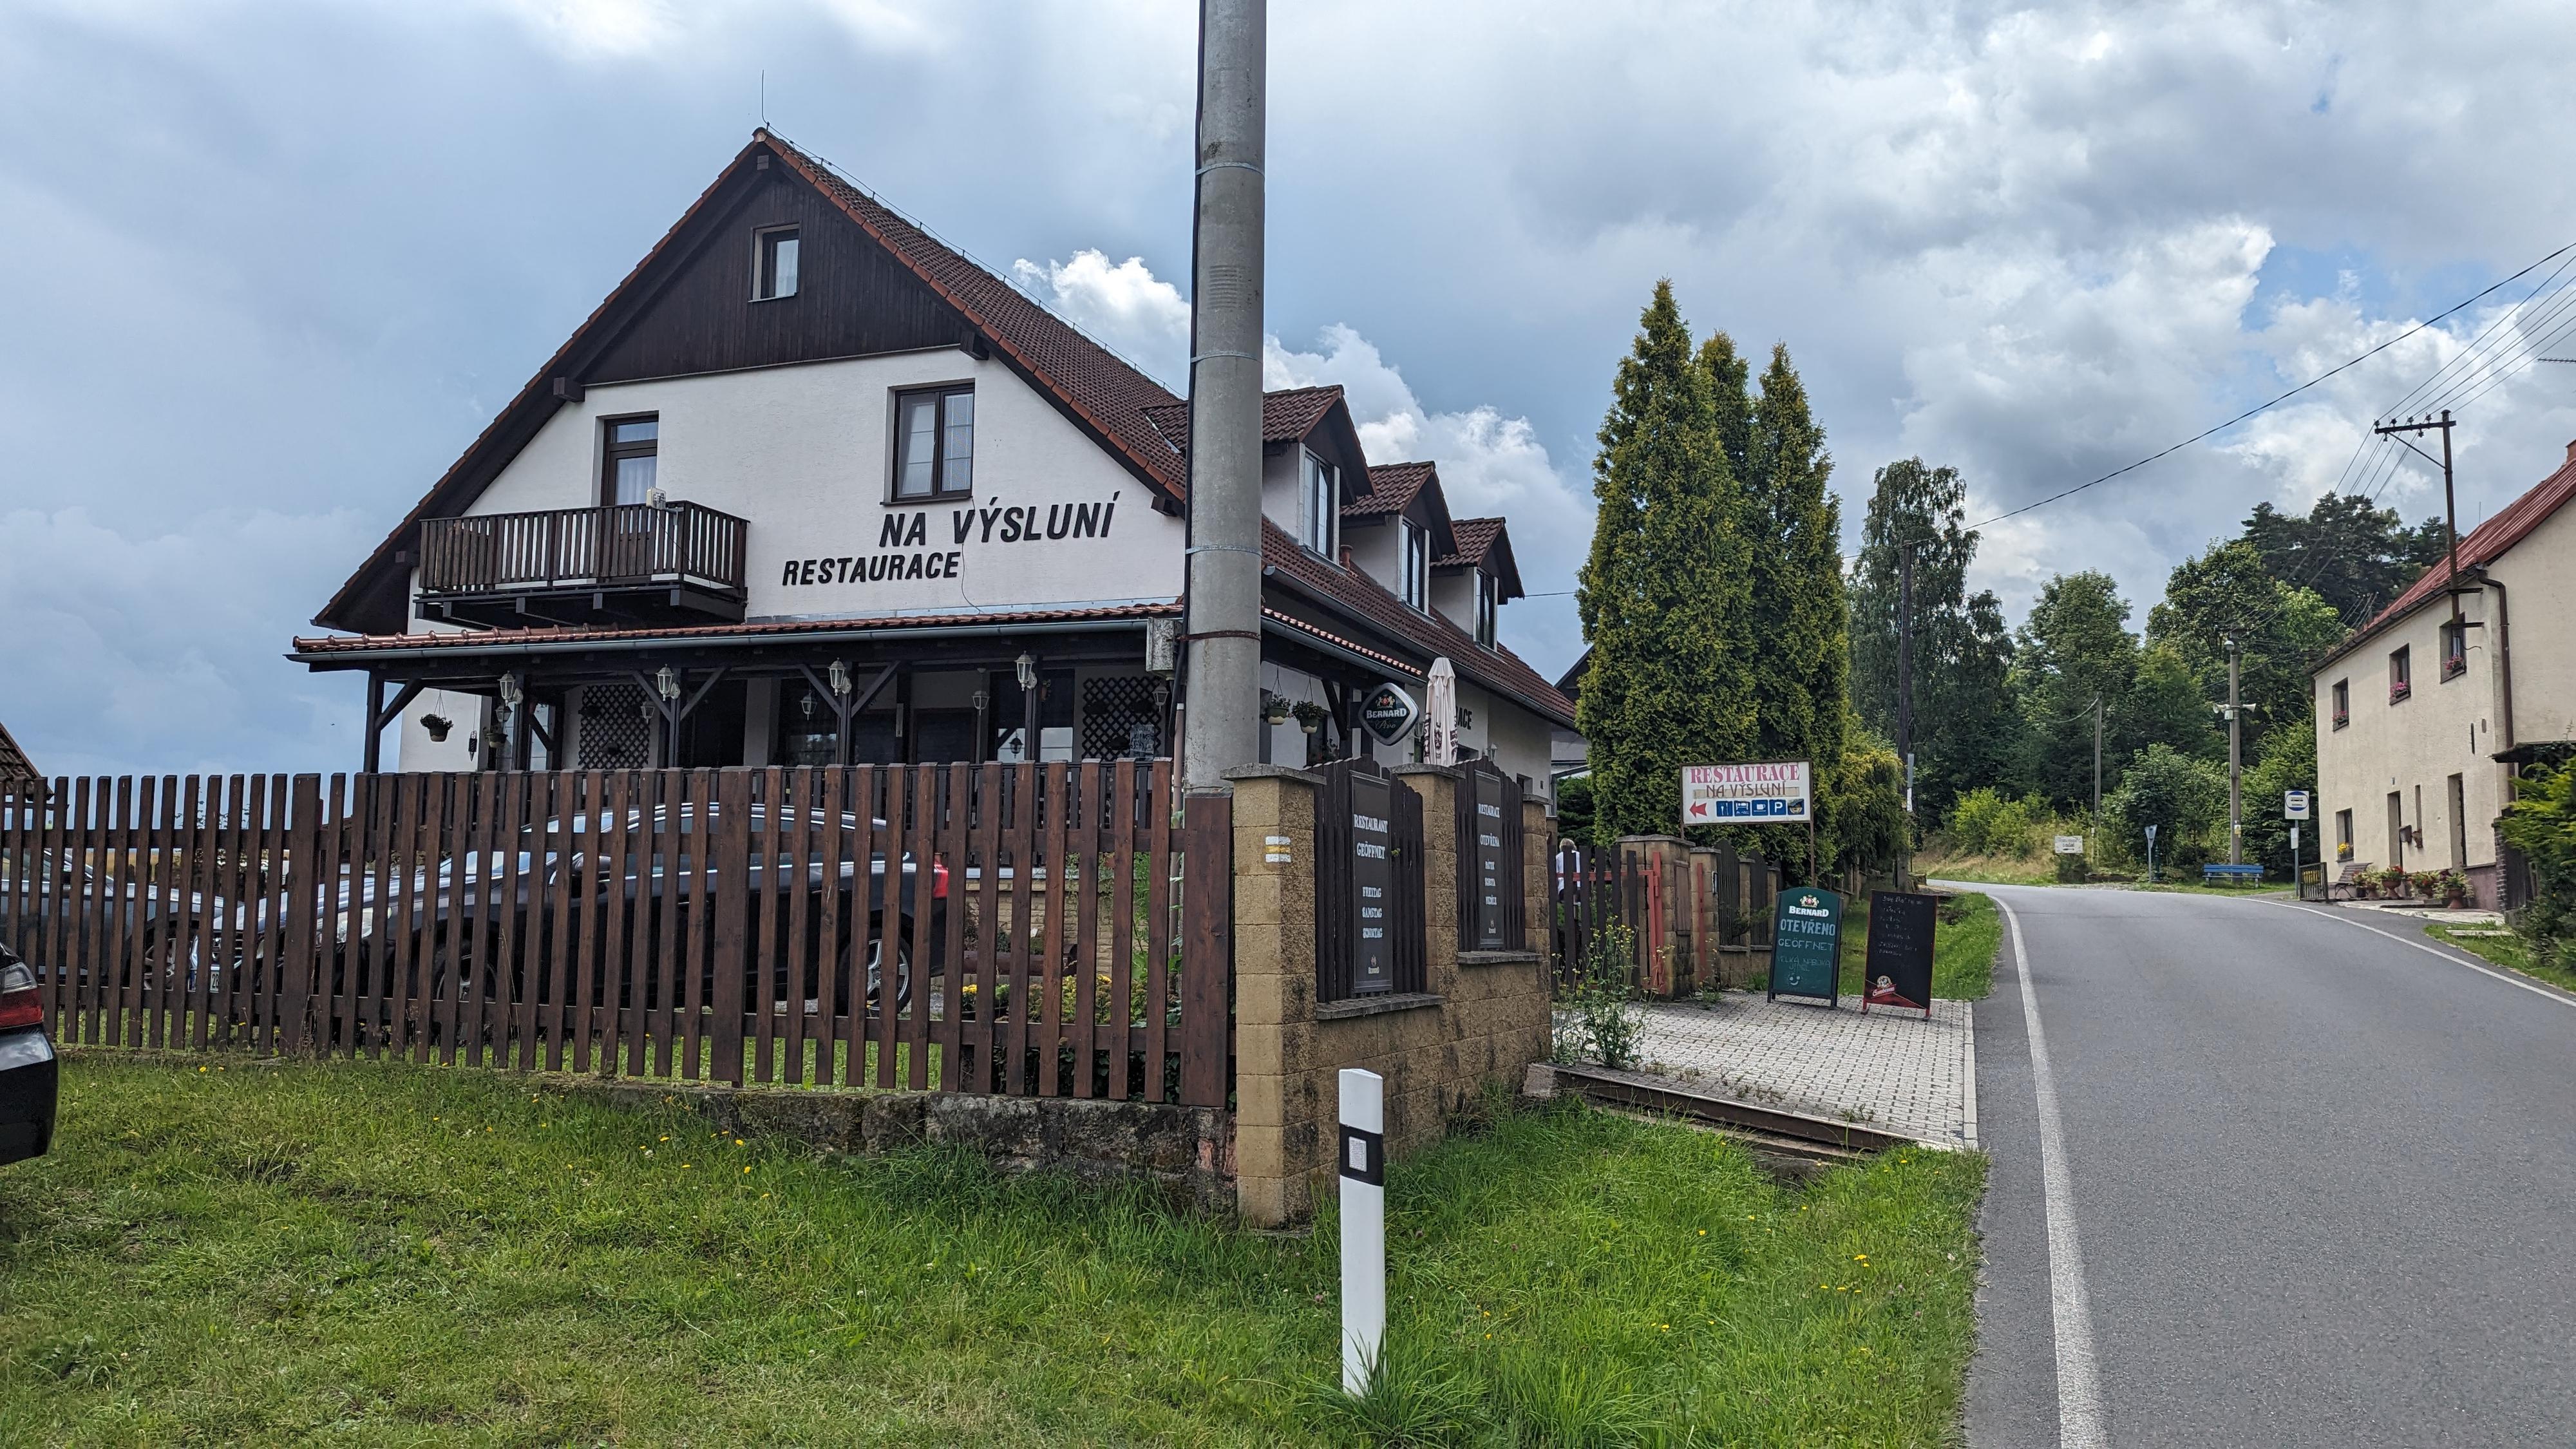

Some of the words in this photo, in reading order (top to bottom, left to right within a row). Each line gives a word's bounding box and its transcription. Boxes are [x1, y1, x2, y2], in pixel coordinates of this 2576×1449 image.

[879, 512, 926, 547] NA
[952, 490, 1121, 545] VÝSLUNÍ
[782, 551, 961, 586] RESTAURACE
[1366, 708, 1407, 719] BERNARD
[1690, 763, 1800, 784] RESTAURACE
[1706, 784, 1725, 798] NA
[1730, 781, 1786, 797] VÝSLUNÍ
[1774, 801, 1783, 813] P
[1354, 813, 1388, 833] RESTAURANT
[1356, 840, 1386, 859] GEÖFFNET
[1788, 905, 1829, 917] BERNARD
[1780, 918, 1836, 936] OTEVŘENO
[1778, 937, 1835, 951] GEÖFFNET
